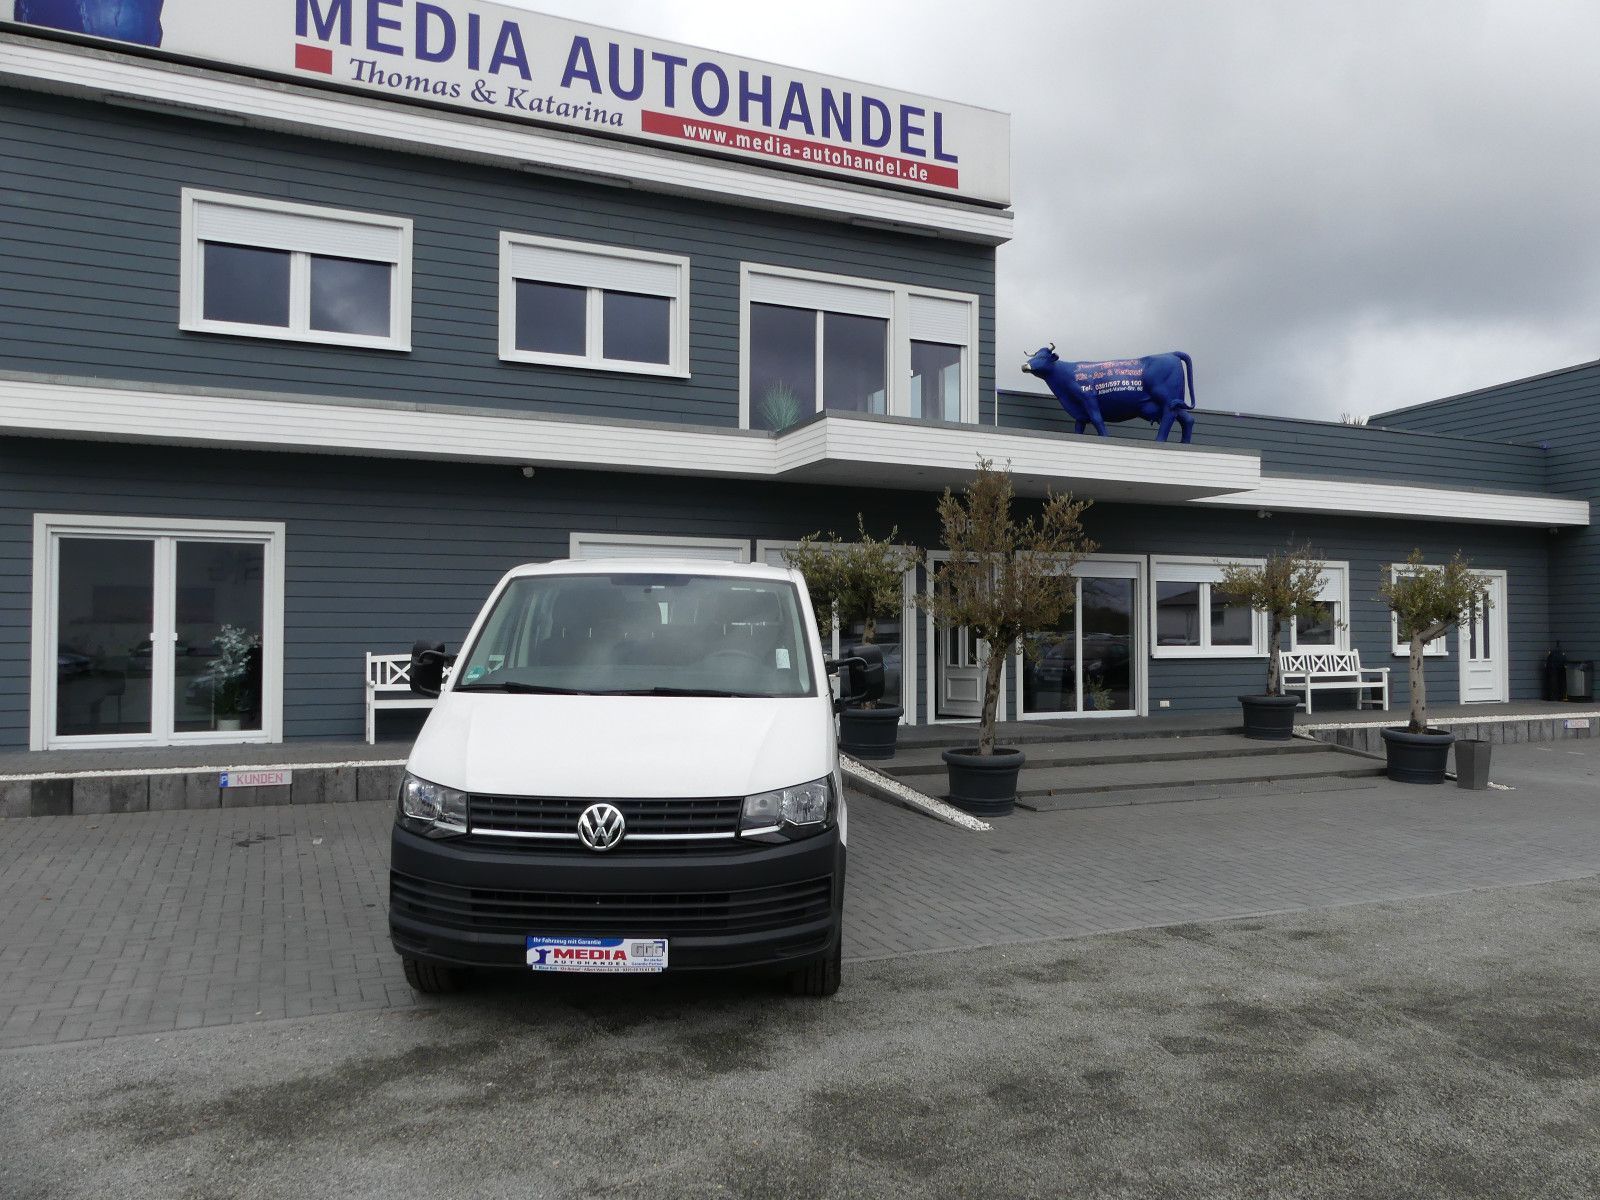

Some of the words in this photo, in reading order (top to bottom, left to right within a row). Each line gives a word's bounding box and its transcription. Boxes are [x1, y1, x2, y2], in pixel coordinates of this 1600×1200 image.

[294, 0, 533, 82] MEDIA
[560, 35, 959, 164] AUTOHANDEL
[350, 57, 462, 99] Thomas
[470, 79, 497, 105] &
[504, 86, 625, 127] Katarina
[682, 122, 929, 182] www.media-autohandel.de
[1081, 384, 1093, 392] Tel.
[236, 772, 284, 785] KUNDEN
[542, 937, 567, 945] Fahrzeug
[553, 948, 627, 960] MEDIA
